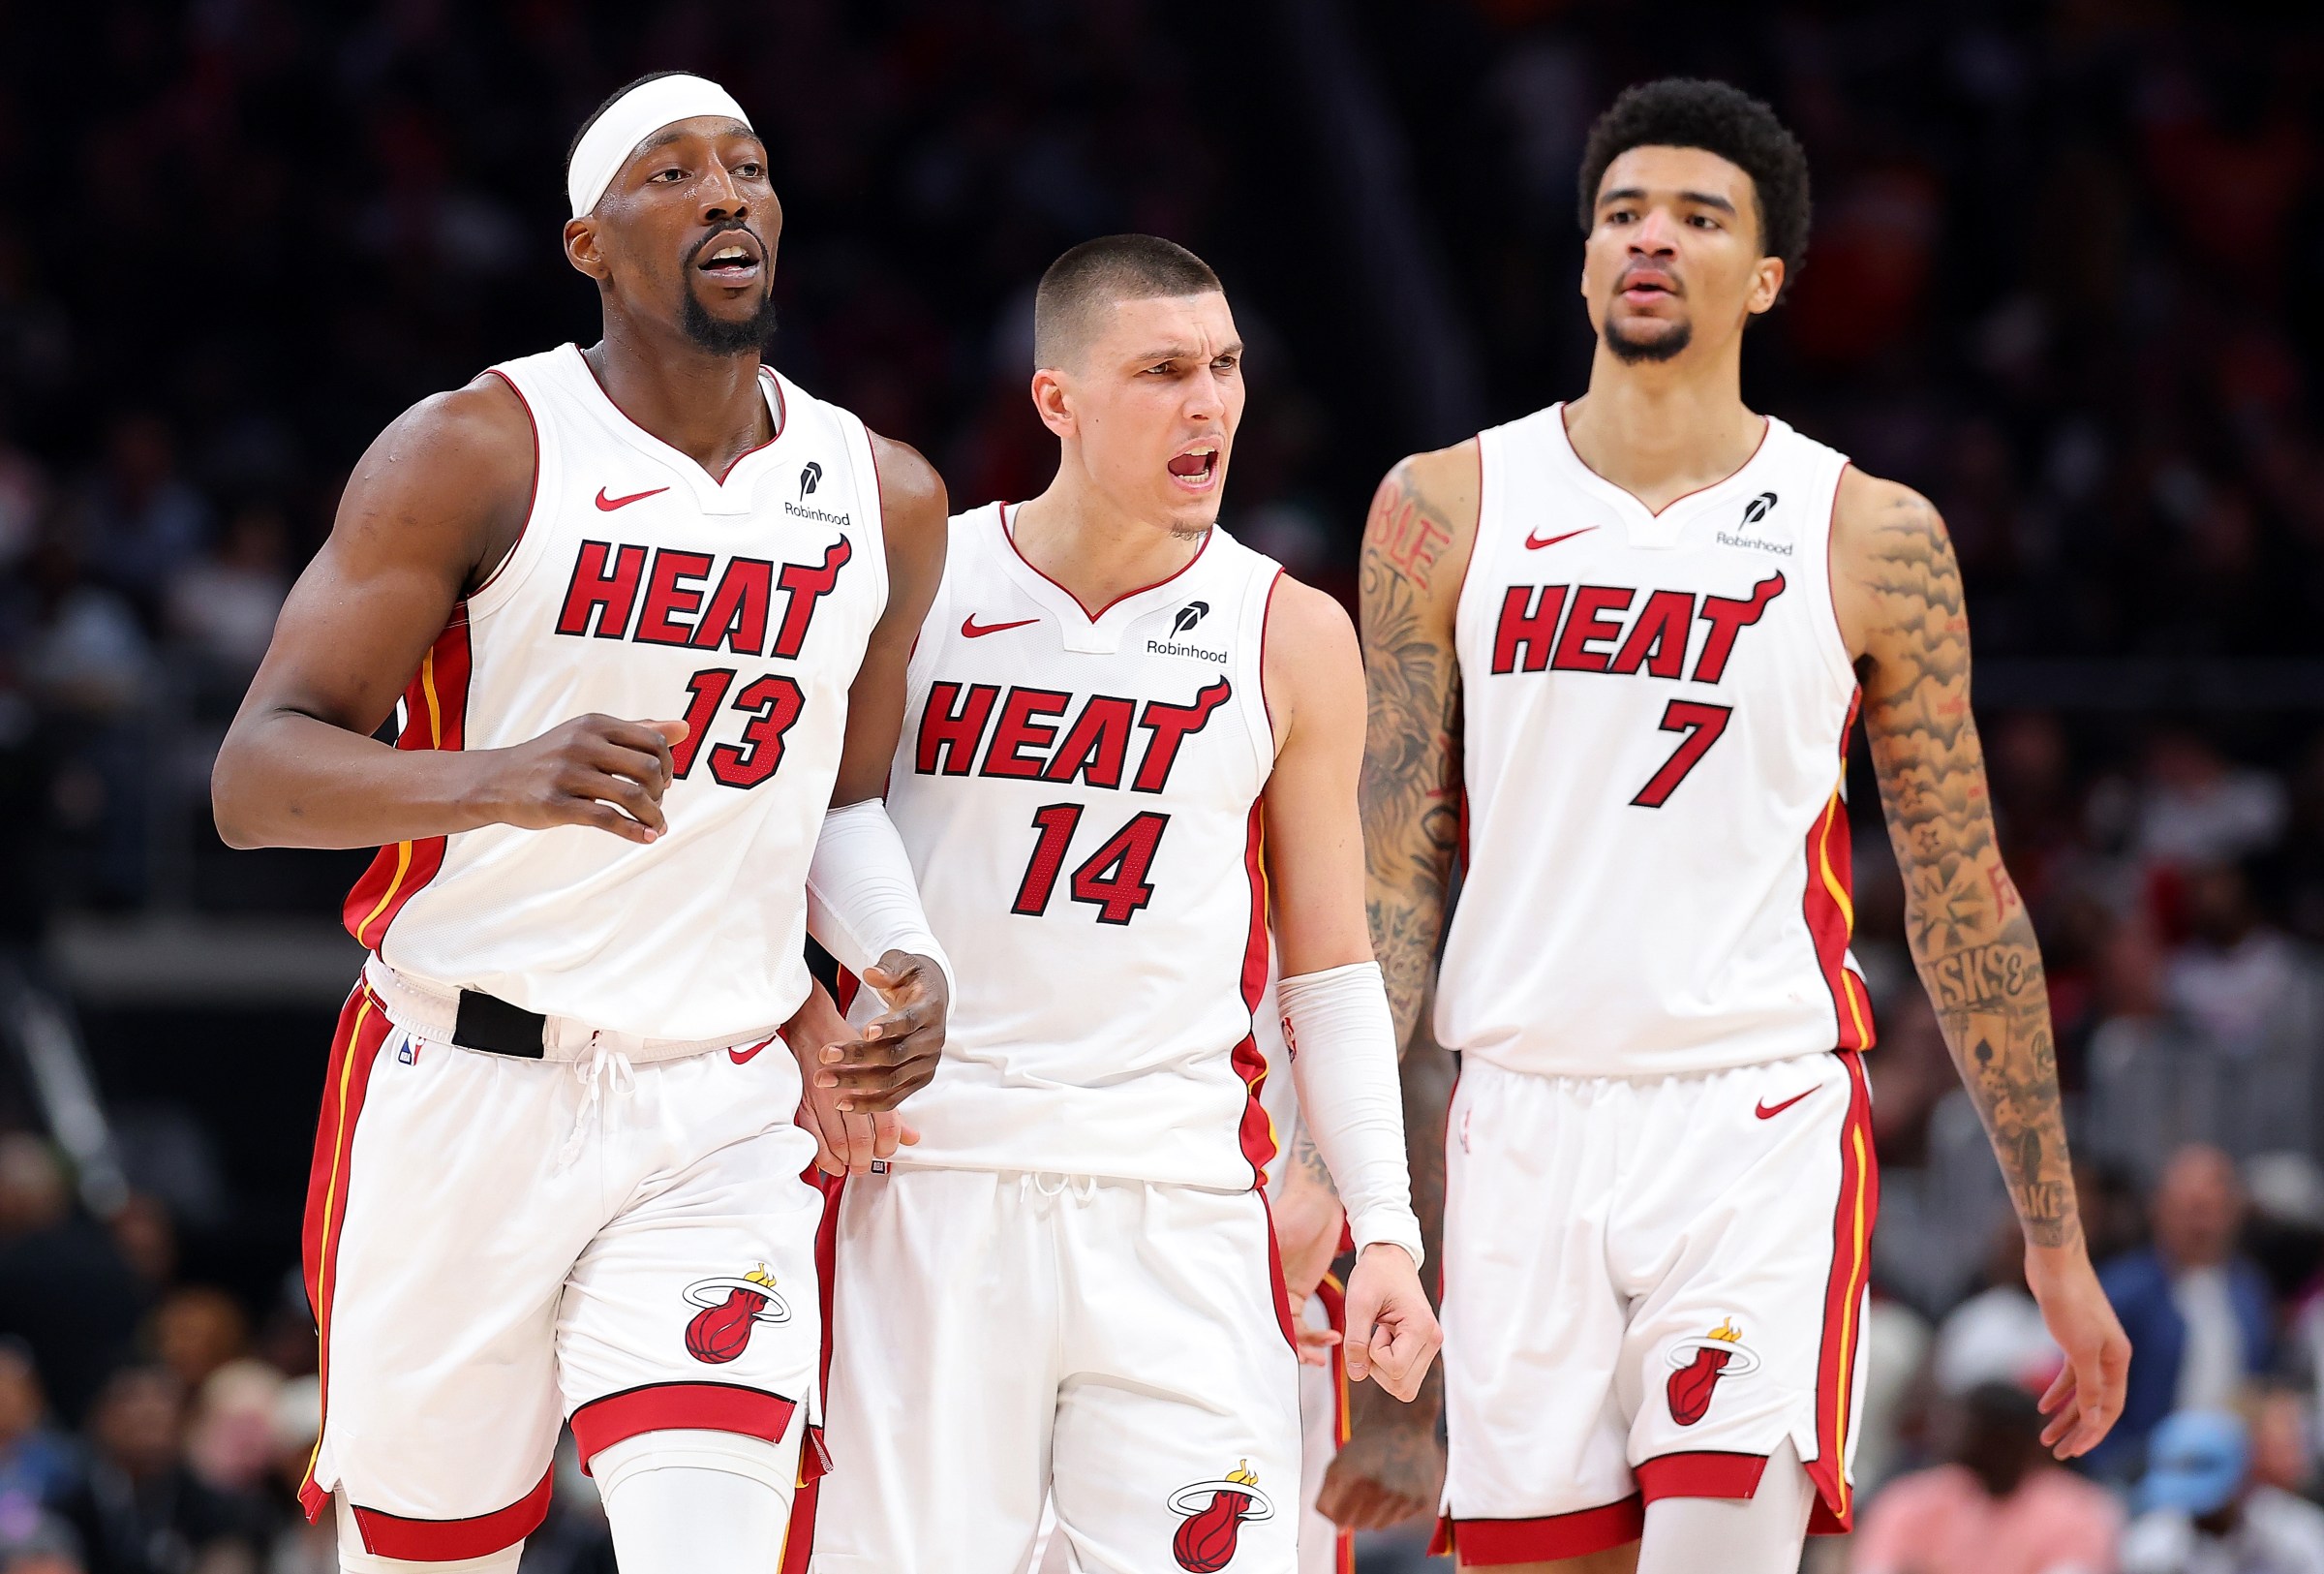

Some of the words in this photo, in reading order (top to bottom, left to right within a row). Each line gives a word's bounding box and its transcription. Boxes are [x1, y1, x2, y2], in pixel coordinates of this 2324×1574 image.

[784, 501, 851, 526] Robinhood
[1716, 531, 1792, 556] Robinhood
[555, 534, 851, 661] HEAT
[1147, 640, 1228, 664] Robinhood
[1491, 571, 1786, 685] HEAT
[672, 667, 806, 789] 13
[915, 675, 1232, 794] HEAT
[1629, 699, 1733, 808] 7
[1011, 803, 1171, 926] 14
